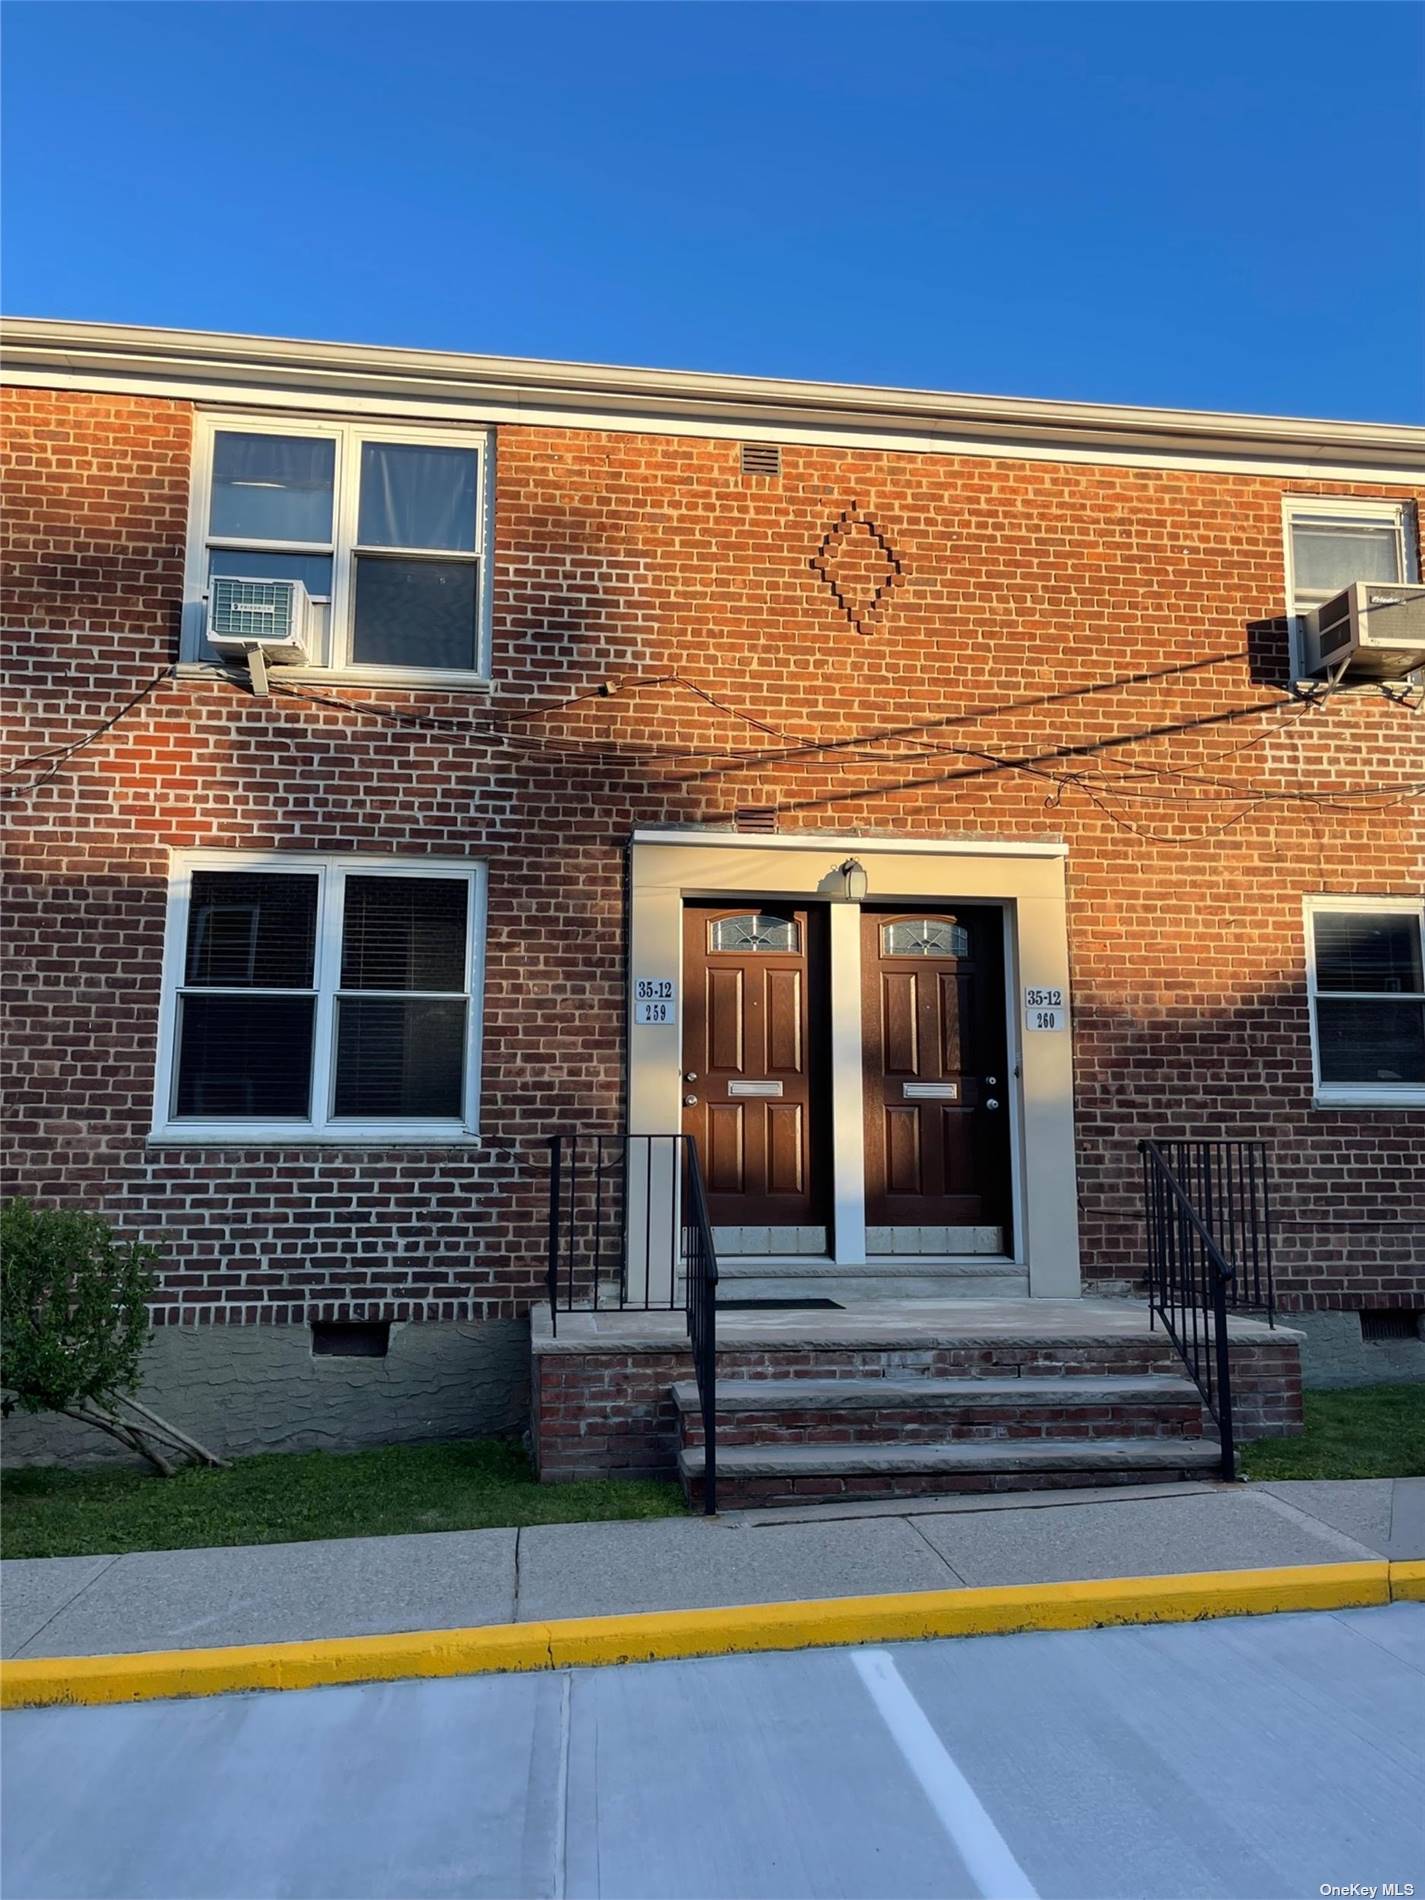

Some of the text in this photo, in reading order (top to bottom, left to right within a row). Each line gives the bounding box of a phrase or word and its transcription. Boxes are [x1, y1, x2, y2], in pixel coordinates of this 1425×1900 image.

[638, 981, 672, 998] 35-12
[1027, 990, 1061, 1006] 35-12
[645, 1004, 666, 1021] 259
[1037, 1012, 1055, 1029] 260
